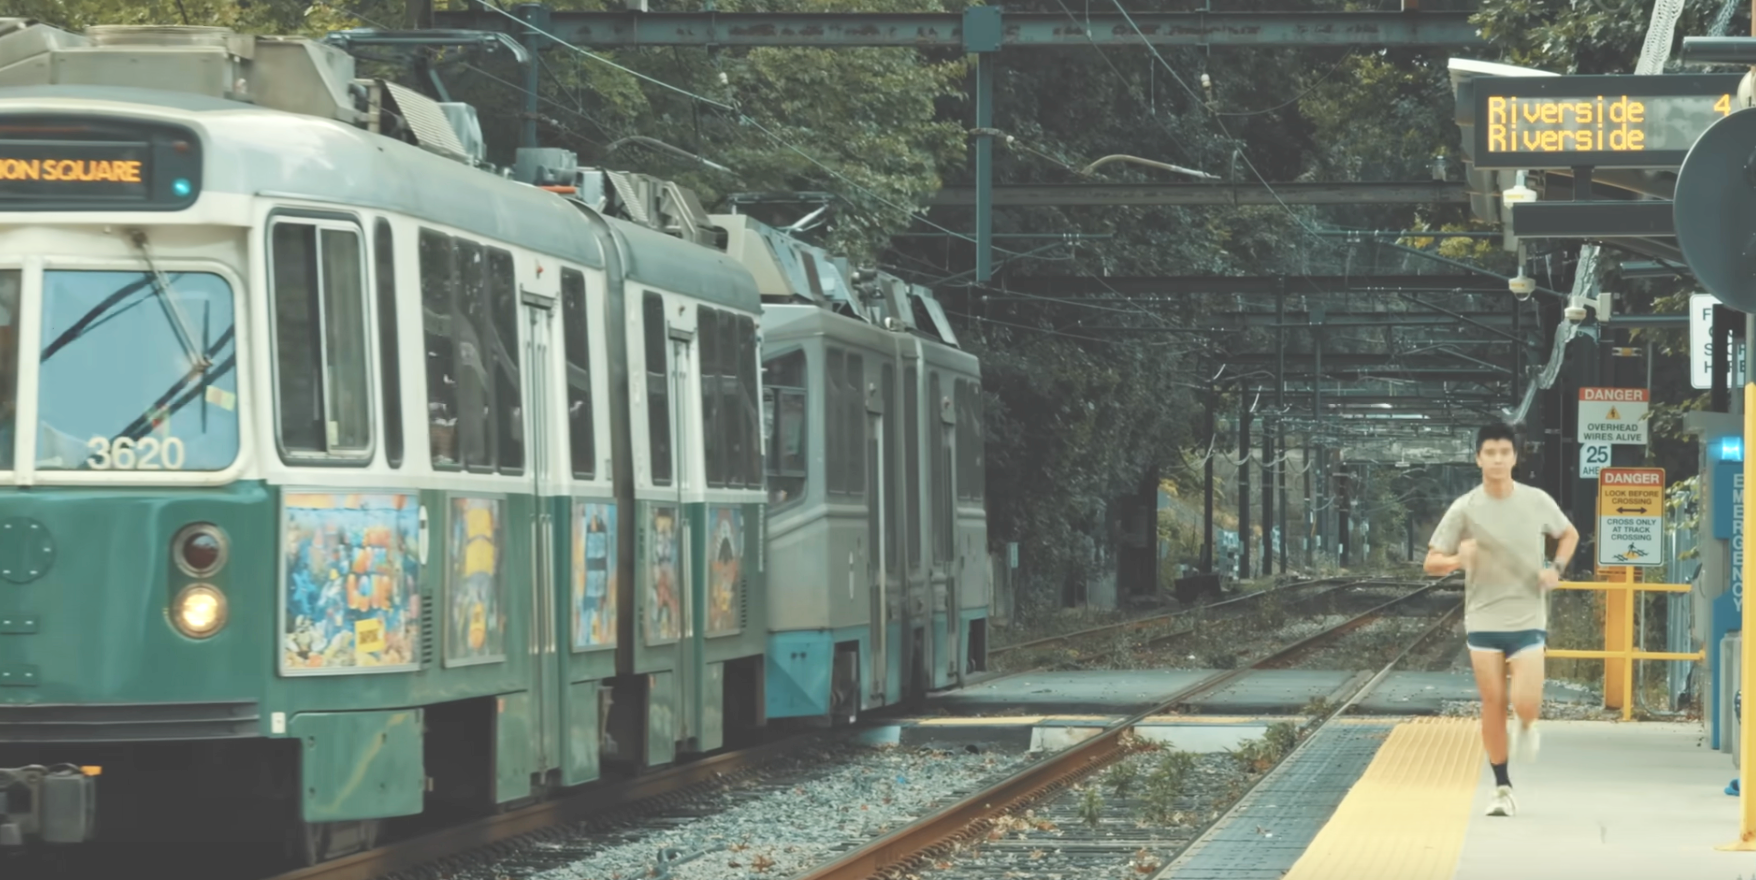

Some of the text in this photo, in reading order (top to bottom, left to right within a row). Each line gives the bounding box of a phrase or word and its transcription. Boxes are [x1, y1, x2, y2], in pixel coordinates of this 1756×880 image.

[1488, 94, 1731, 124] Riverside 4
[1488, 124, 1645, 152] Riverside
[42, 159, 142, 182] SQUARE
[1584, 389, 1643, 401] DANGER
[1587, 423, 1638, 432] OVERHEAD
[1584, 433, 1642, 442] WIRES ALIVE
[87, 437, 185, 470] 3620
[1586, 446, 1609, 463] 25
[1605, 473, 1660, 484] DANGER
[1629, 490, 1660, 498] BEFORE
[1732, 473, 1744, 612] EMERGENCY
